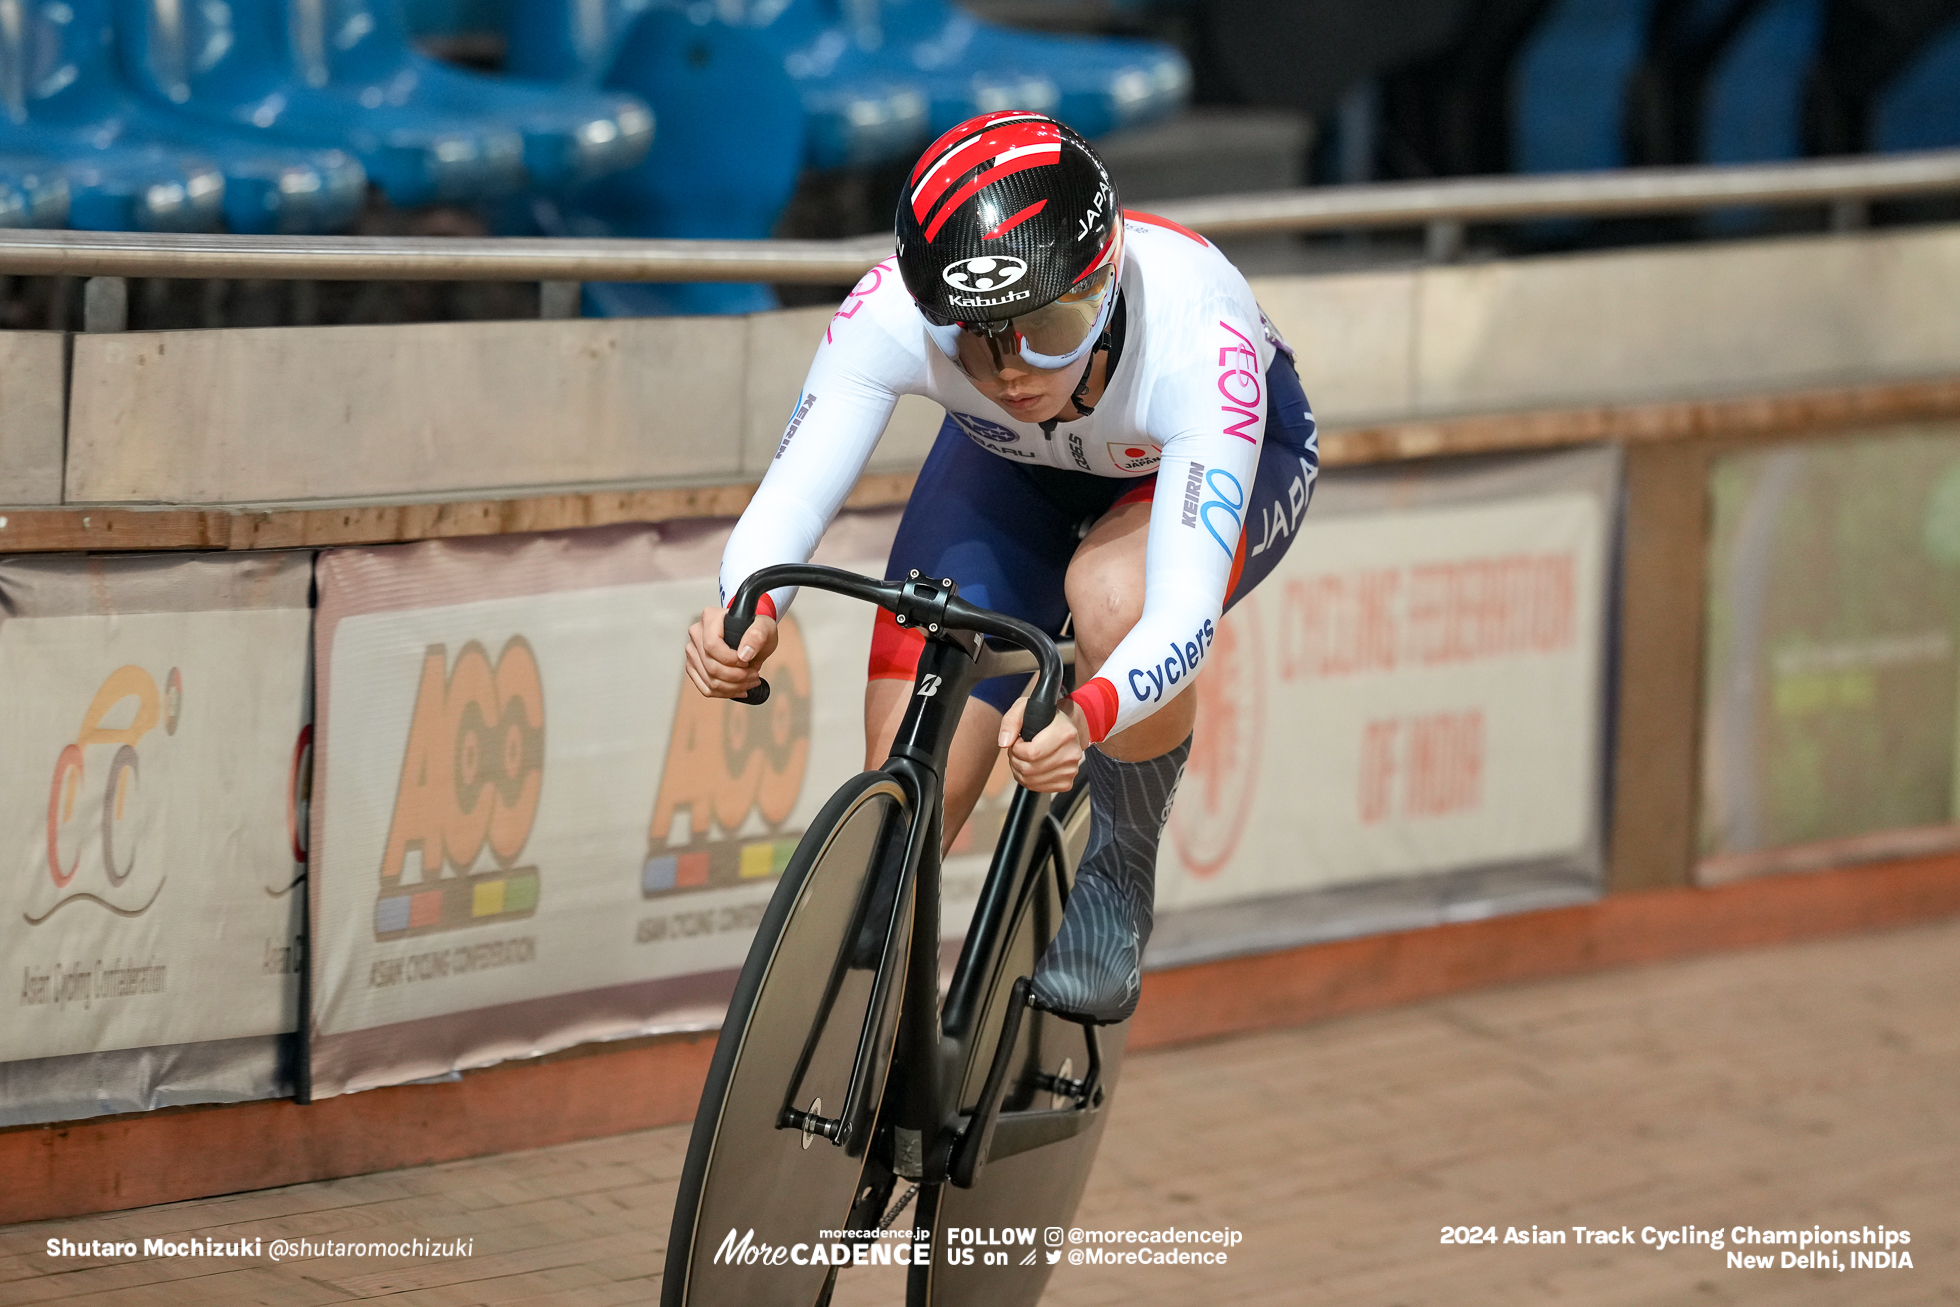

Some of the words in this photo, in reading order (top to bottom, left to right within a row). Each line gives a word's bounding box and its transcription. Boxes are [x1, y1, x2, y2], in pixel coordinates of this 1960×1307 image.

[948, 290, 1030, 307] Kabuto
[775, 393, 818, 460] KEIRIN
[1125, 457, 1161, 469] JAPAN
[1181, 461, 1205, 528] KEIRIN
[1251, 412, 1319, 558] JAPAN
[1128, 618, 1214, 703] Cyclers
